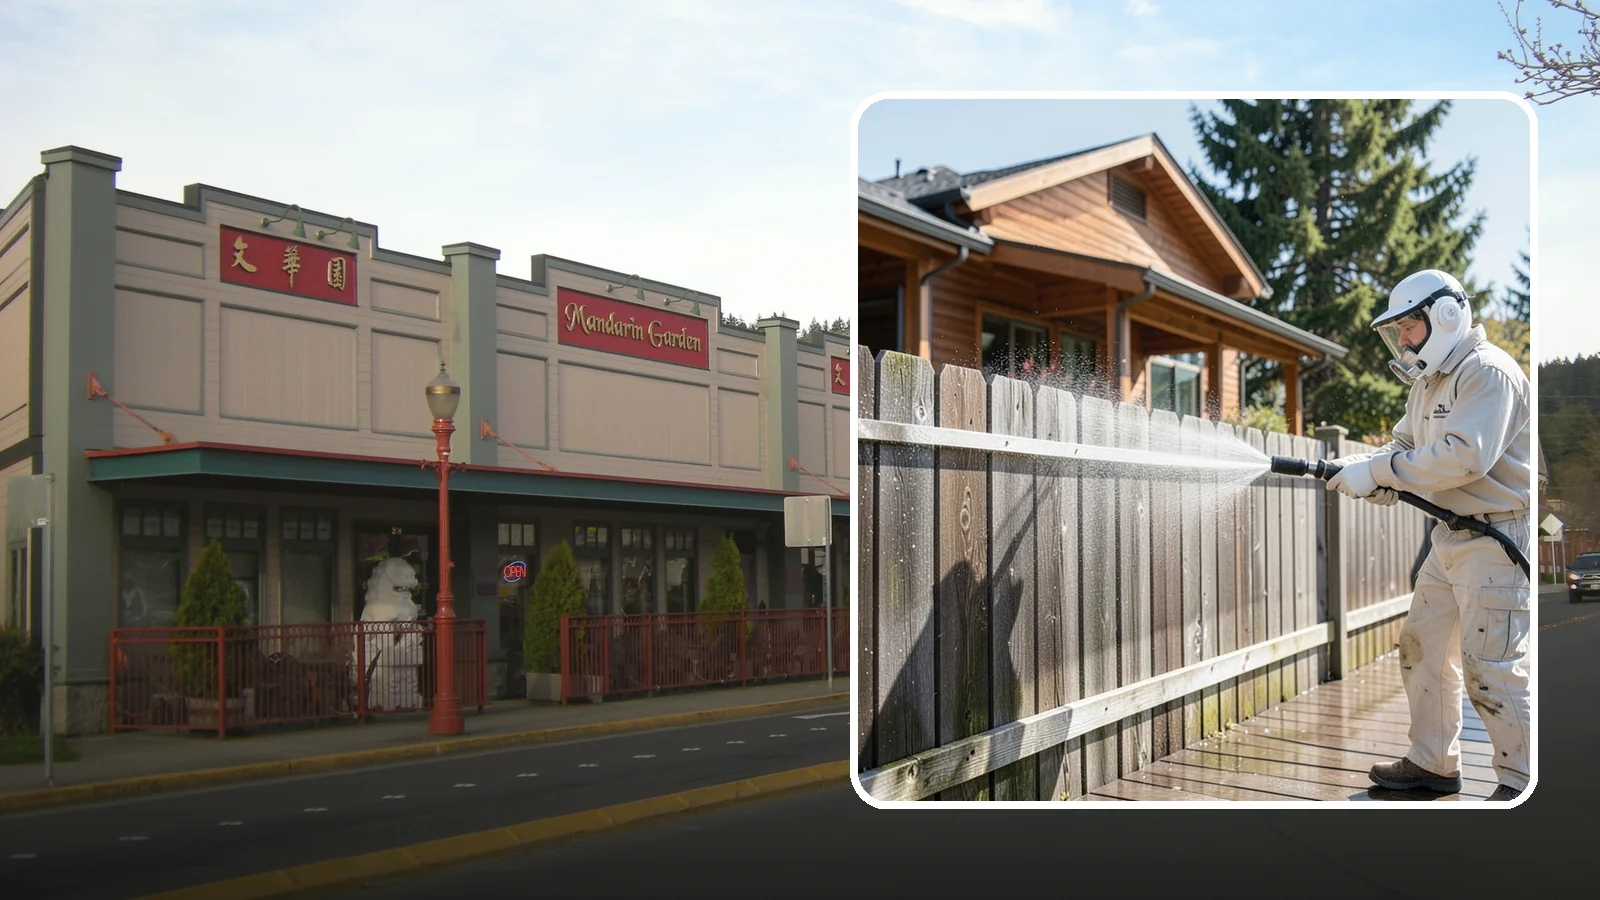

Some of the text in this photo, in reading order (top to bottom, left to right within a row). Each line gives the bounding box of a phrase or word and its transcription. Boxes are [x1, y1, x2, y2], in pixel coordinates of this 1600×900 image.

[231, 235, 346, 291] 文華園
[564, 302, 702, 352] Mandarin Garden
[503, 565, 527, 578] OPEN
